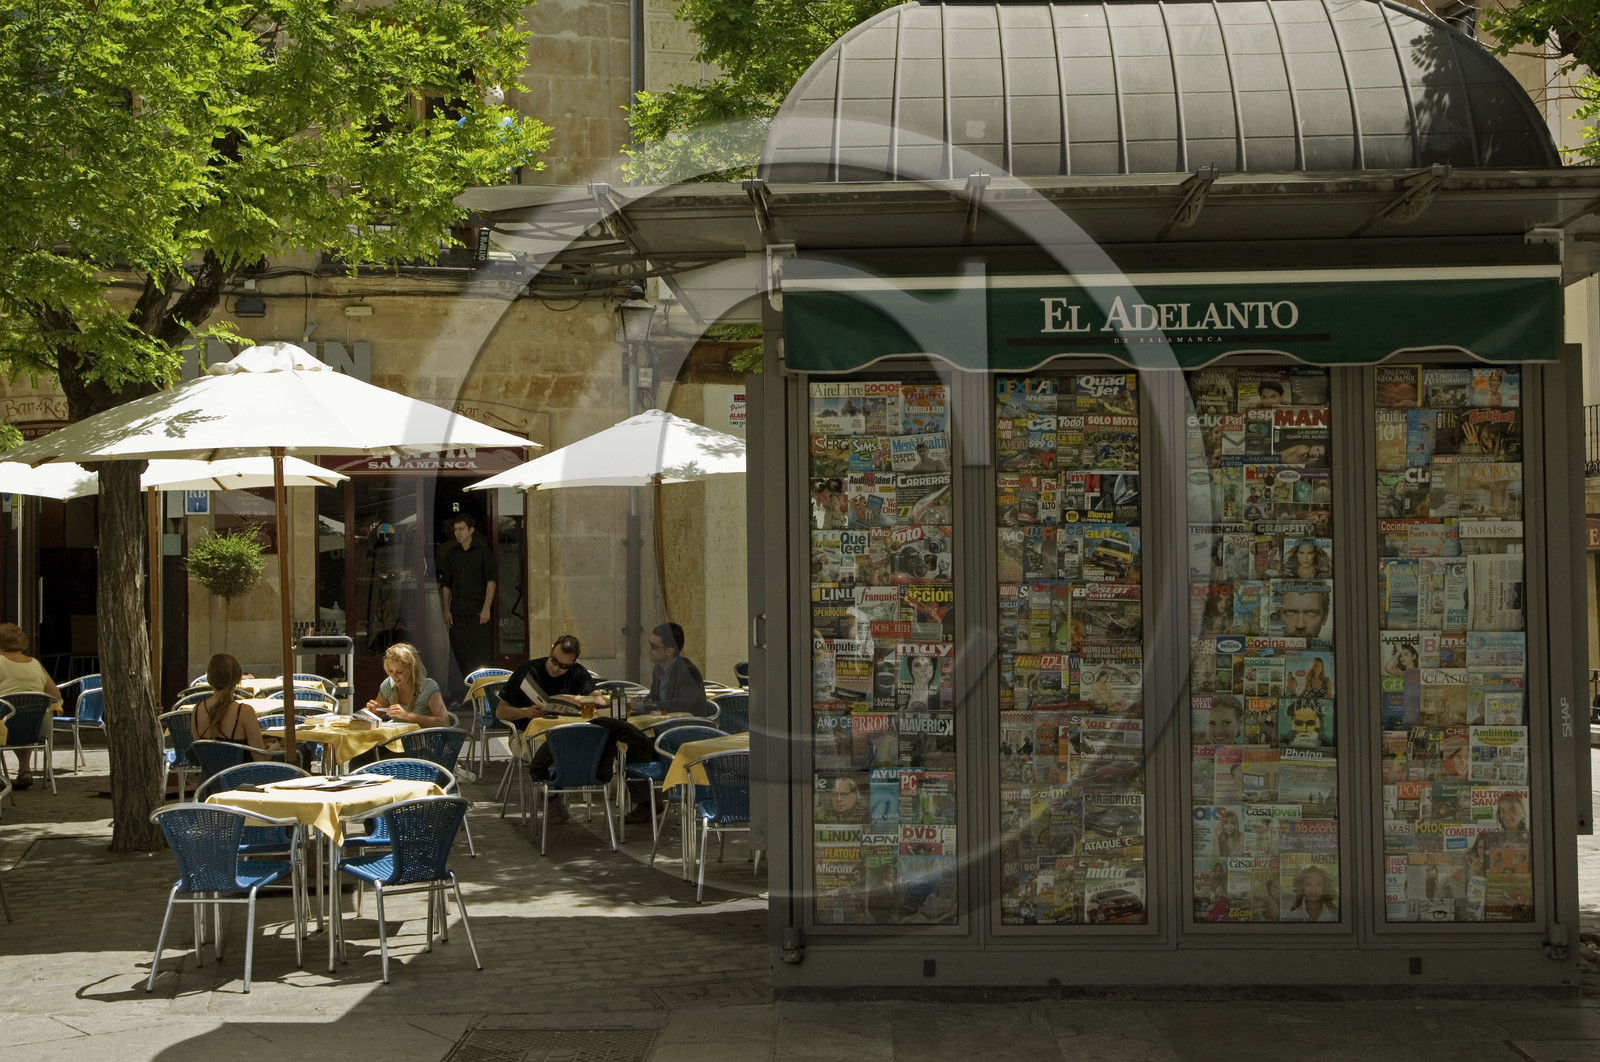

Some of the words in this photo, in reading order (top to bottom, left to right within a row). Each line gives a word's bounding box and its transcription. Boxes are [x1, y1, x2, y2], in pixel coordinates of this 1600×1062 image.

[1040, 297, 1090, 333] EL
[1100, 296, 1299, 331] ADELANTO
[1139, 335, 1223, 343] SALAMANCA
[1079, 375, 1125, 389] Quad
[1088, 416, 1111, 425] SOLO
[1112, 416, 1138, 425] MOTO
[1275, 409, 1328, 426] MAN
[1462, 463, 1520, 478] COCINAS
[897, 475, 950, 487] CARRERAS
[1189, 525, 1243, 534] TENDENCIAS
[1381, 521, 1408, 531] Cocinas
[841, 532, 866, 544] Que
[841, 545, 866, 554] leer
[905, 587, 953, 602] acción
[898, 644, 953, 657] muy
[900, 718, 953, 735] MAVERICK
[1473, 728, 1525, 737] Ambientes
[902, 775, 917, 790] PC
[1472, 799, 1499, 807] SANA
[903, 828, 936, 839] DVD
[1445, 827, 1476, 837] COMER
[1085, 840, 1120, 851] ATAQUE
